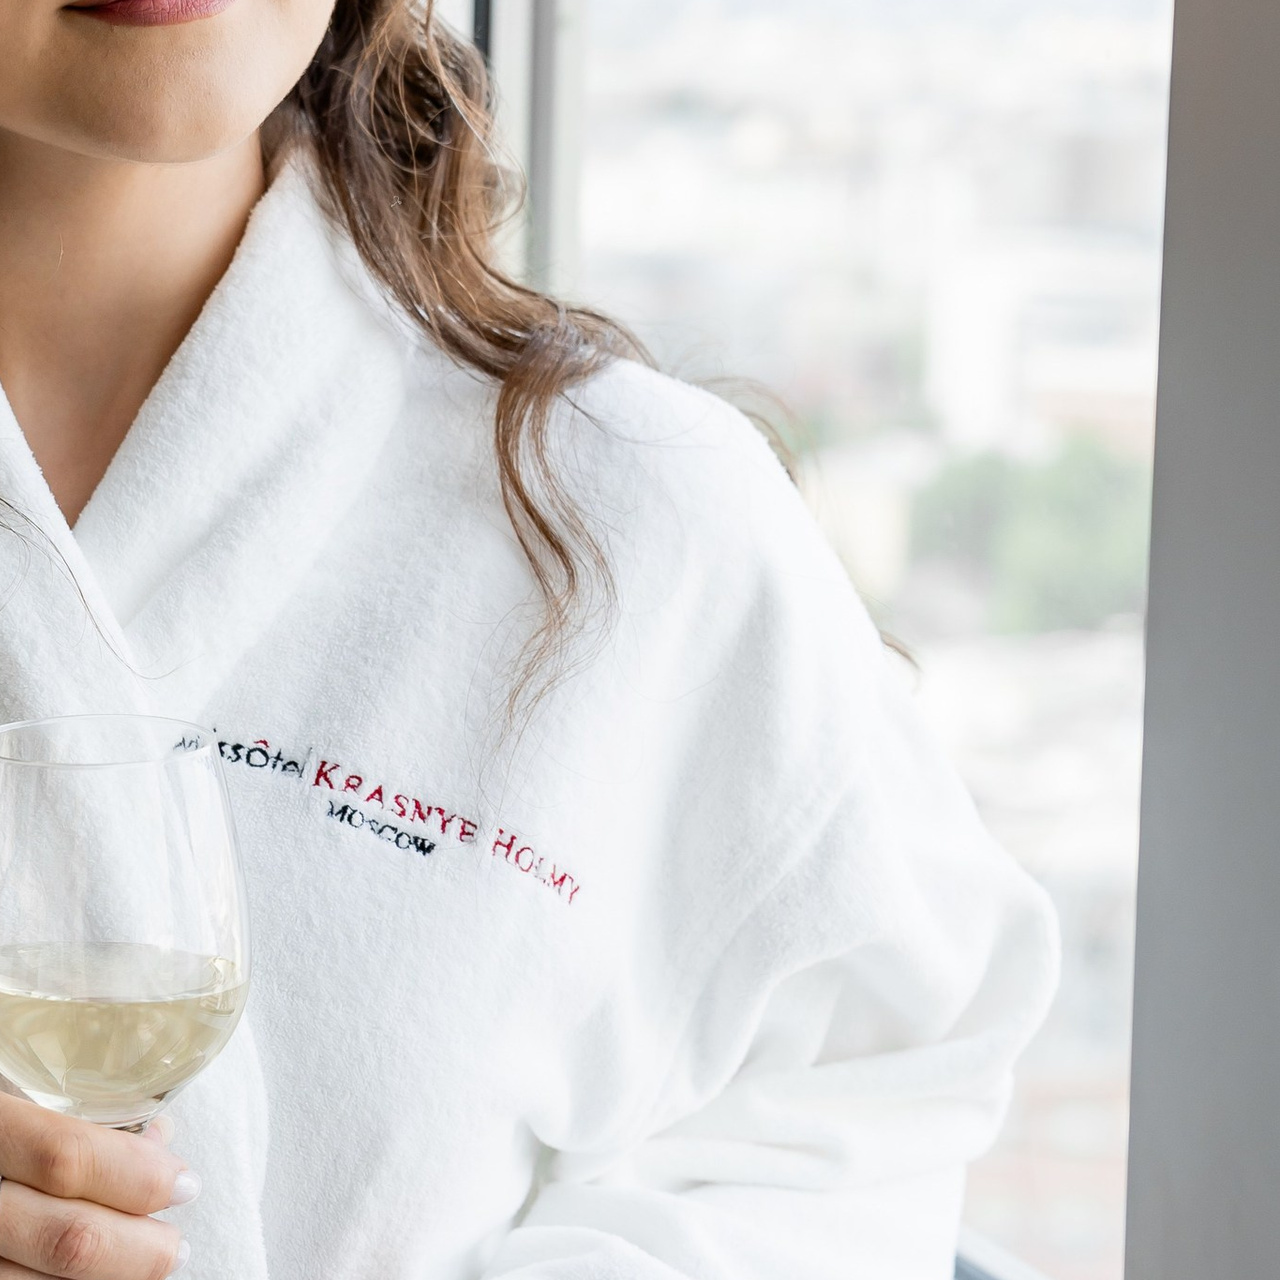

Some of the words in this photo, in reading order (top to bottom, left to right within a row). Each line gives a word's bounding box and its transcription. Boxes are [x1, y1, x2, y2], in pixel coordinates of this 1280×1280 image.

[312, 759, 478, 843] KRASNYE
[491, 828, 581, 905] HOLMY
[326, 800, 436, 857] MOSCOW
